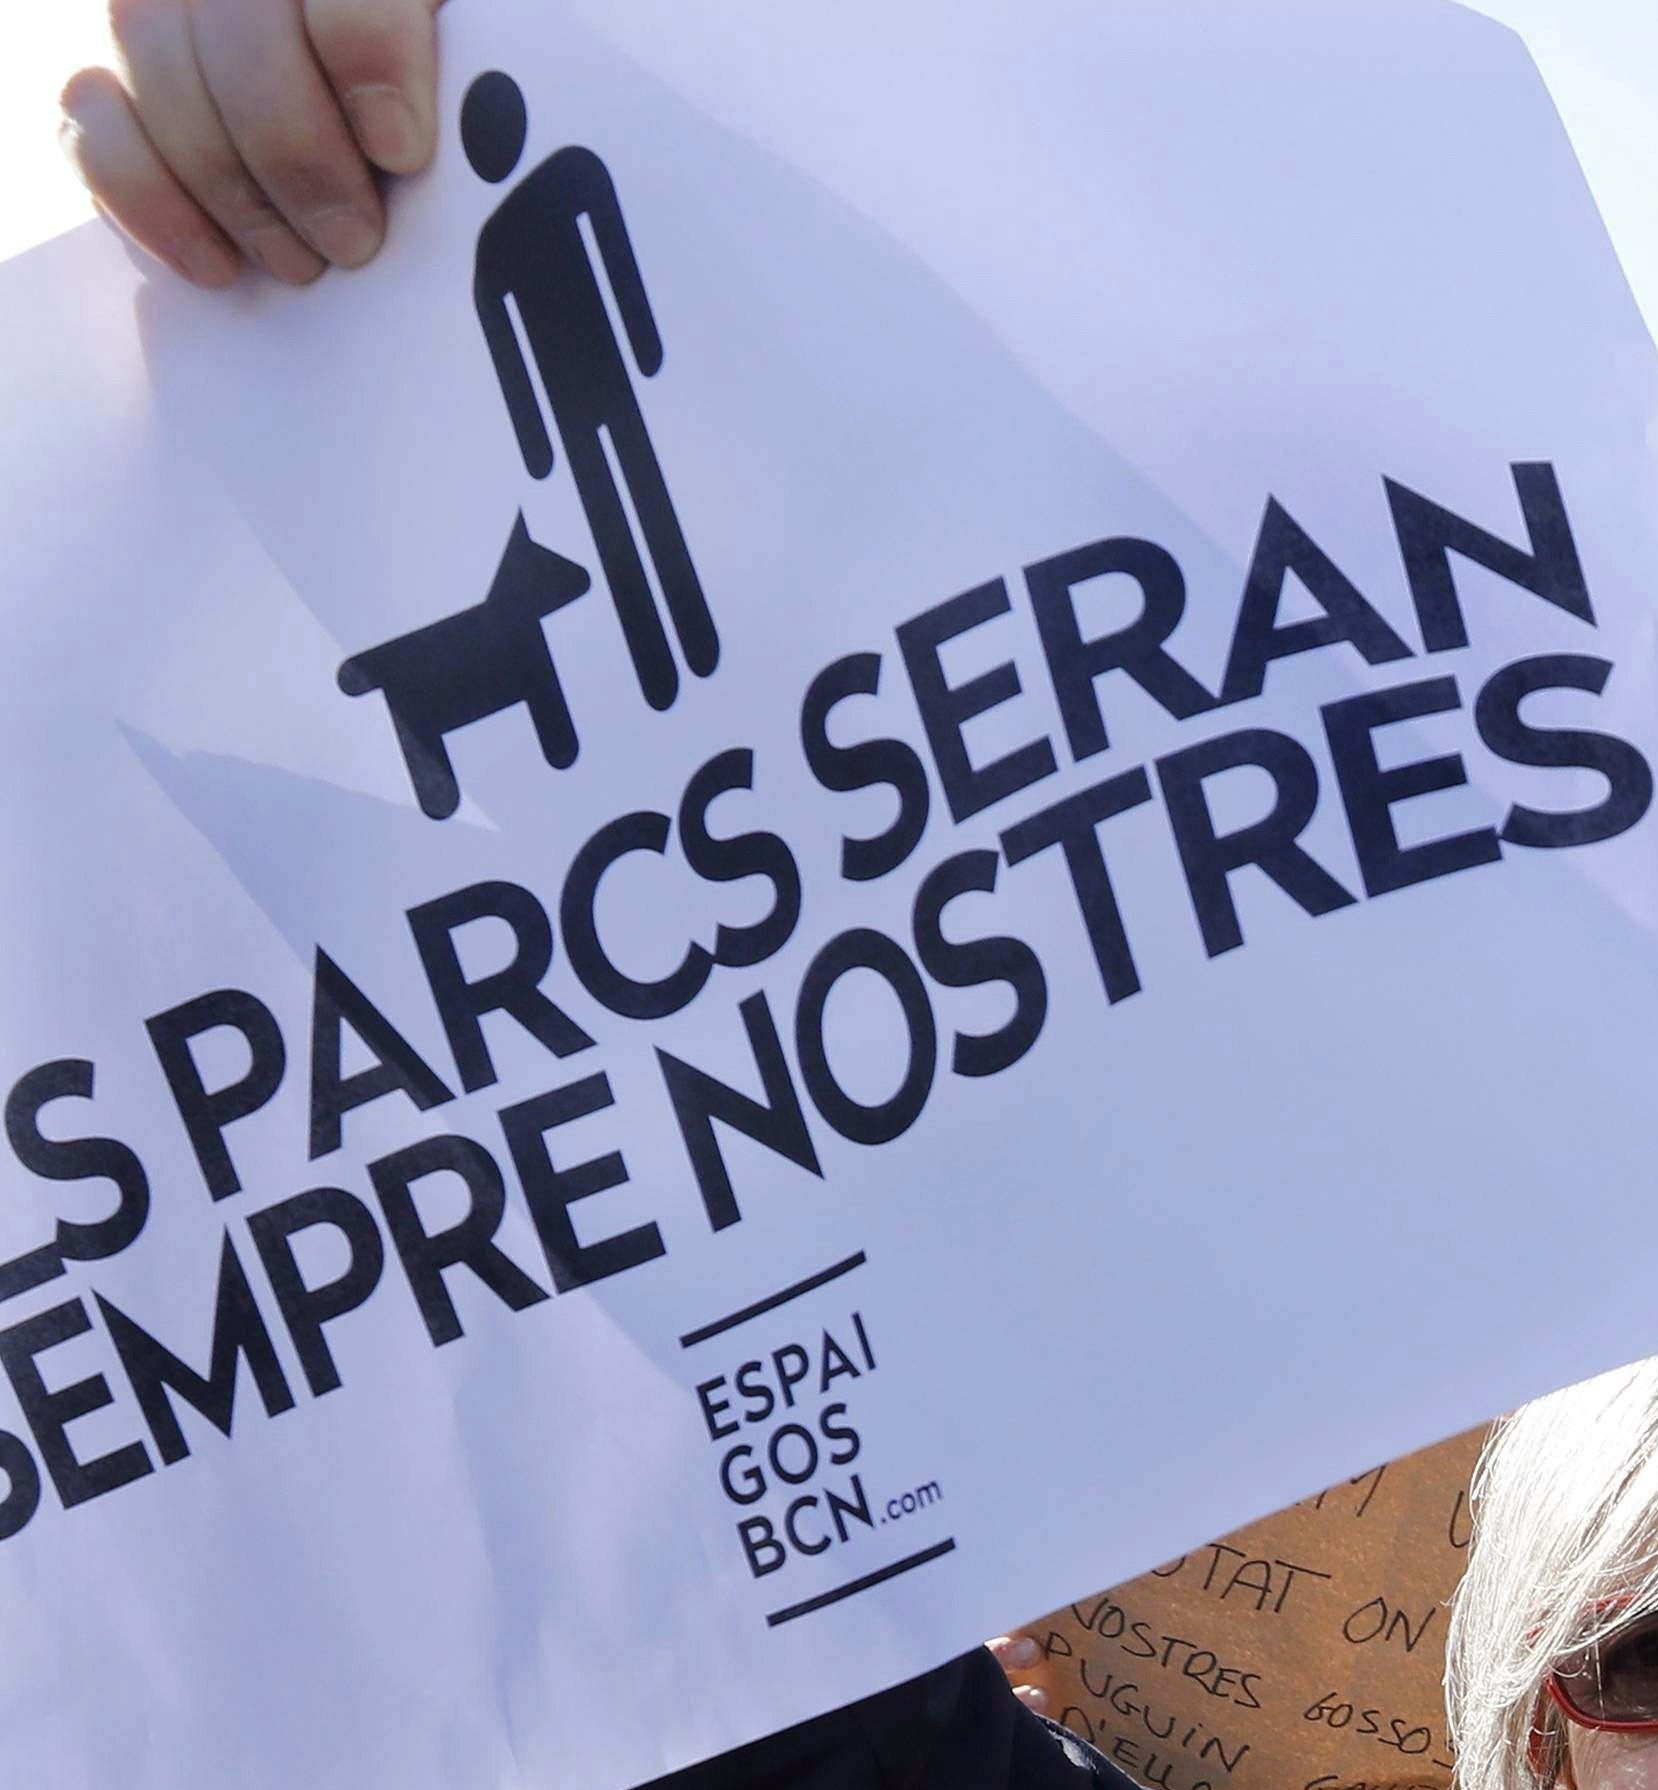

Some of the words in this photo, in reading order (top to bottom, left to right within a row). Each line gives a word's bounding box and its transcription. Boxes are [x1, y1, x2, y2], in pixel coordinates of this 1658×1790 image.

[143, 747, 802, 1203] PARCS
[800, 460, 1599, 883] SERAN
[654, 652, 1655, 1234] NOSTRES
[695, 1310, 876, 1442] ESPAI
[719, 1402, 861, 1506] GOS
[1343, 1597, 1436, 1652] ON
